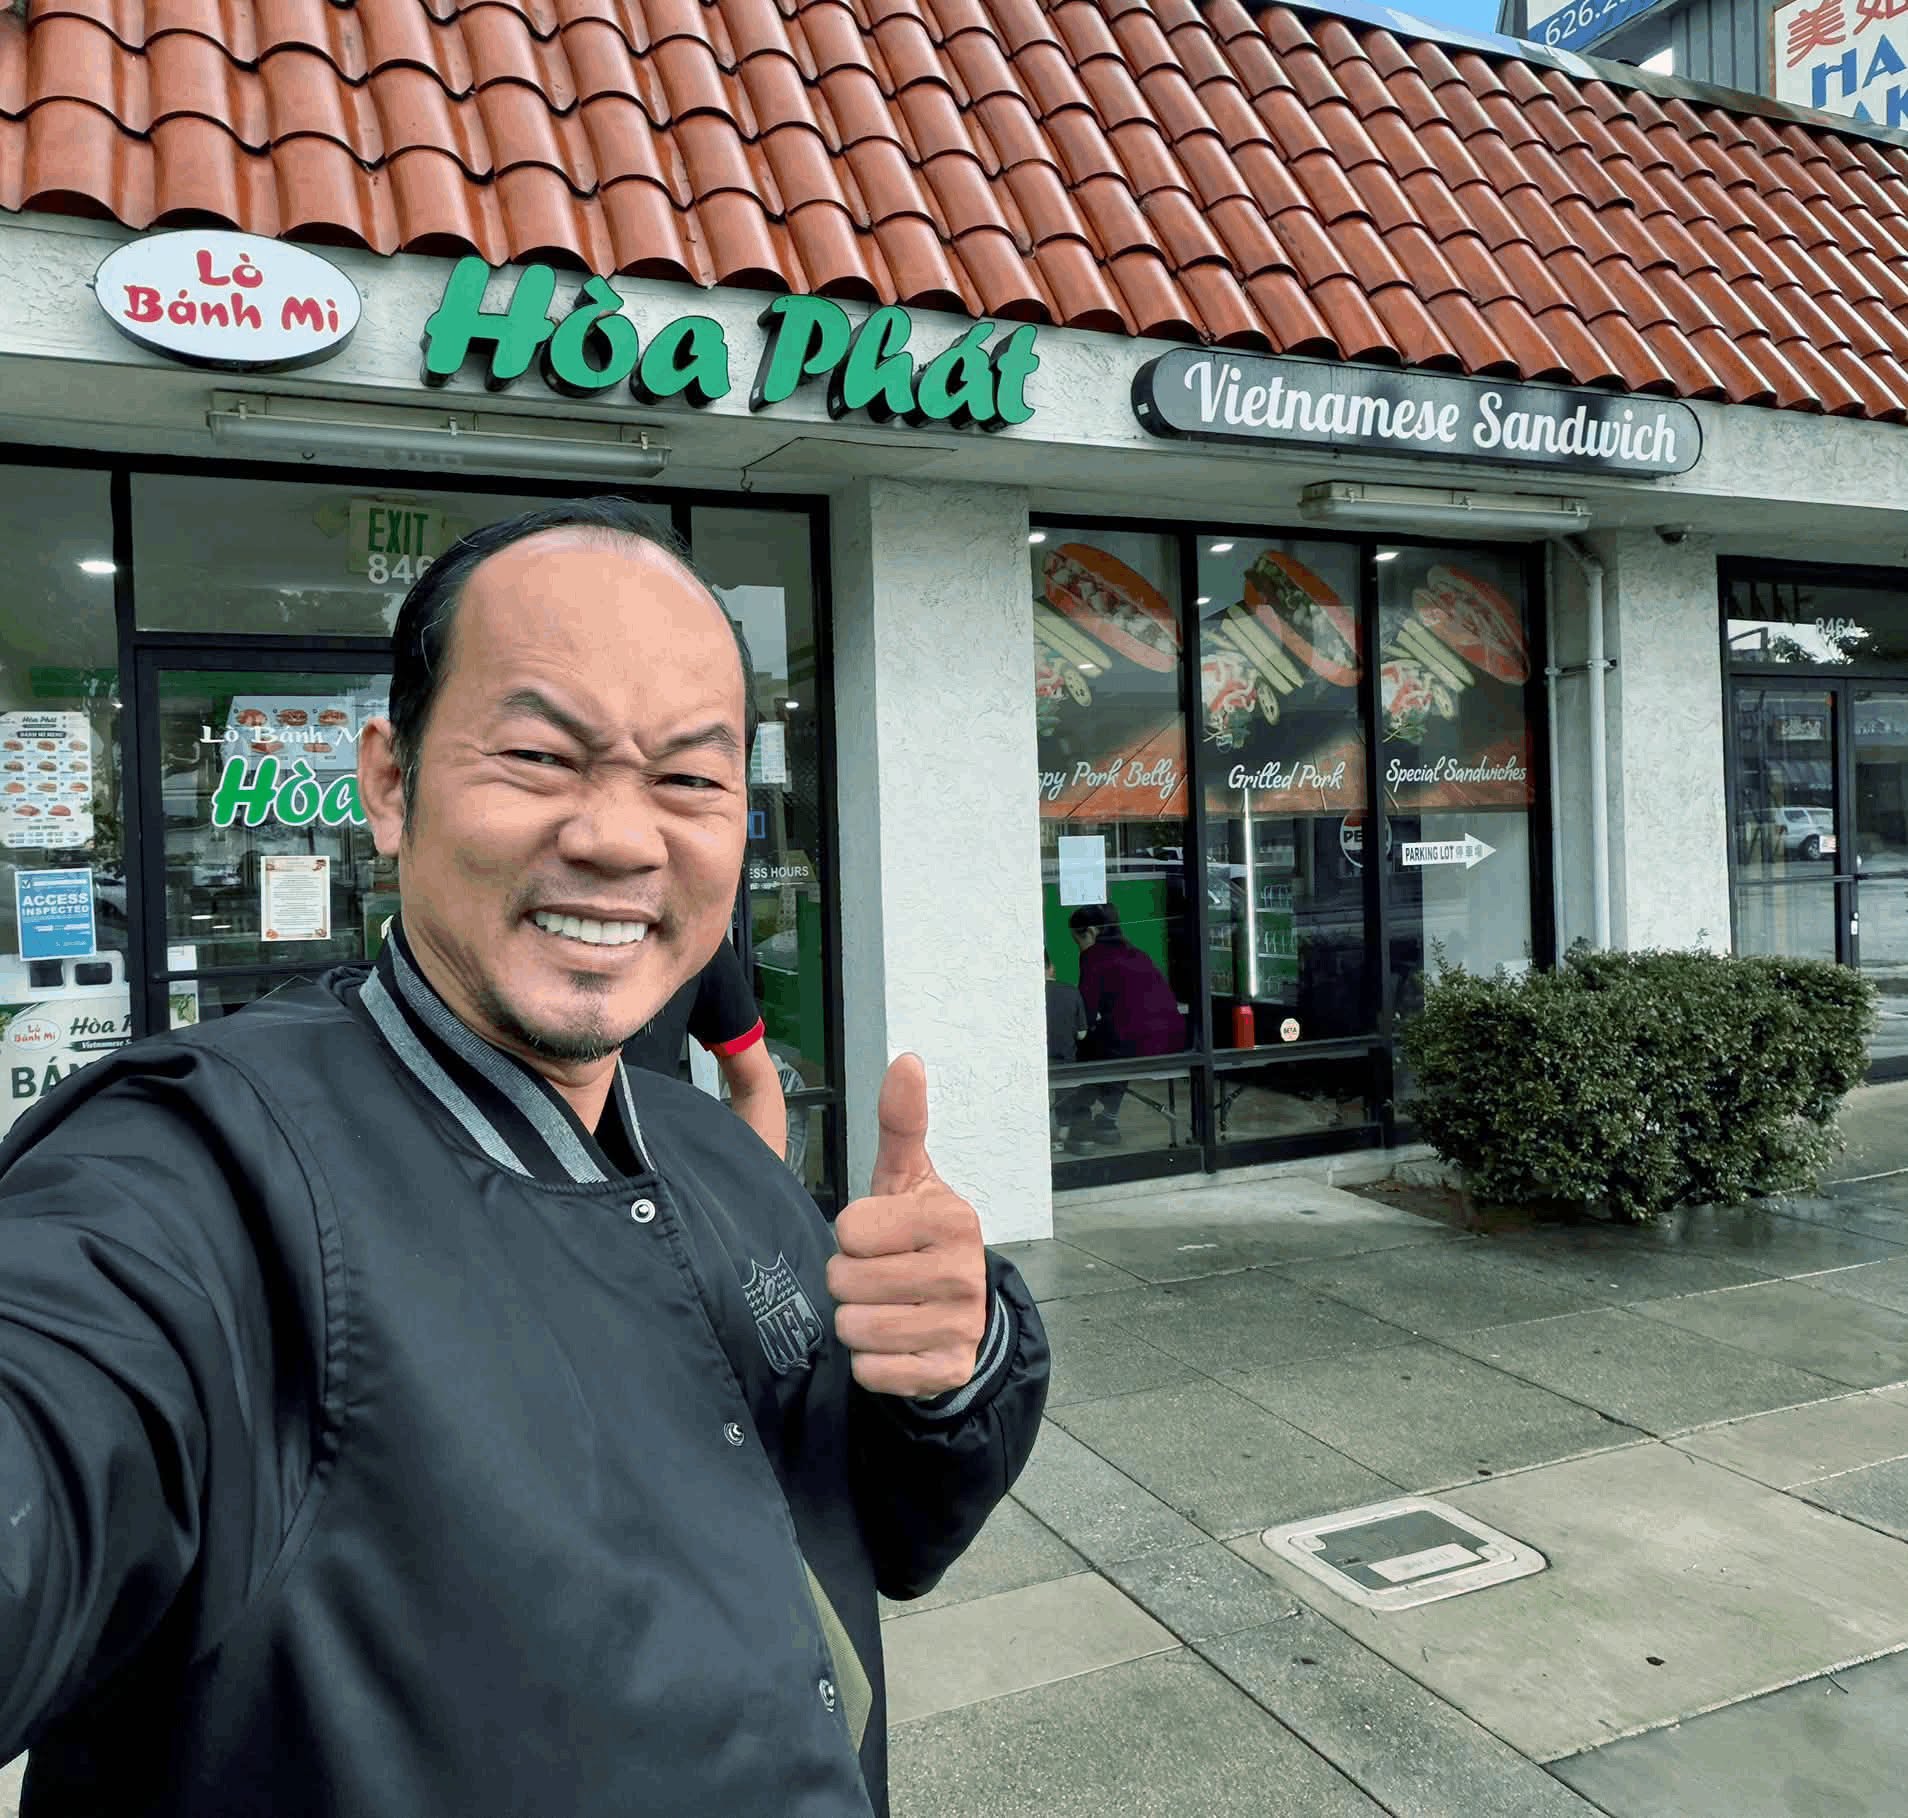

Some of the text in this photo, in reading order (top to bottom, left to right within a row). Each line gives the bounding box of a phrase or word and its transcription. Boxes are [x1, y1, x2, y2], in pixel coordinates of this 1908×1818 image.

[196, 249, 263, 288] Lò
[123, 285, 339, 333] Bánh Mì
[424, 256, 1040, 425] Hòa Phát
[1184, 361, 1678, 464] Vietnamese Sandwich
[368, 507, 429, 556] EXIT
[1815, 617, 1856, 636] 846A
[200, 725, 364, 747] Lò Bánh M
[212, 755, 367, 827] Hòa
[1072, 758, 1123, 788] Pork
[1124, 758, 1177, 799] Belly
[1228, 761, 1346, 790] Grilled Pork
[1386, 755, 1527, 792] Special Sandwiches
[771, 866, 809, 878] HOURS
[1405, 846, 1438, 862] PARKING
[1440, 845, 1453, 860] LOT
[22, 893, 88, 906] ACCESS
[22, 905, 89, 916] INSPECTED
[70, 1017, 116, 1035] Hòa
[11, 1056, 81, 1098] BÁ
